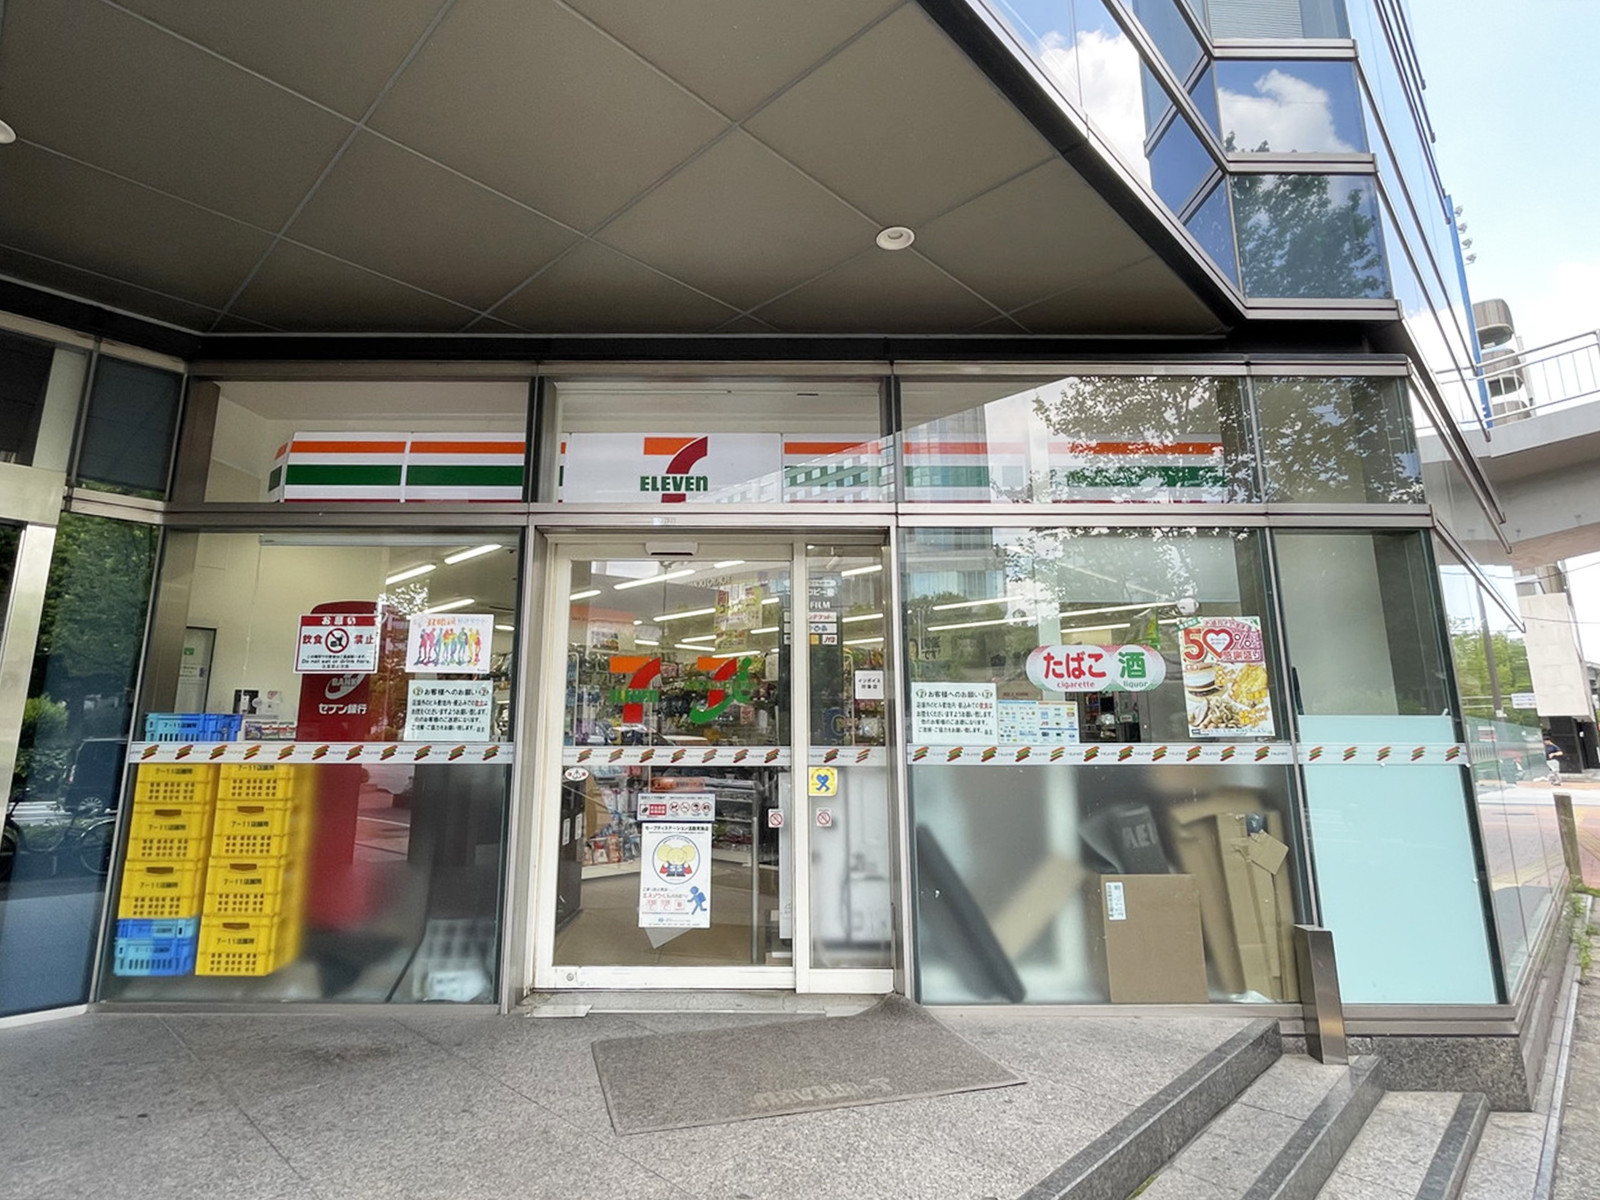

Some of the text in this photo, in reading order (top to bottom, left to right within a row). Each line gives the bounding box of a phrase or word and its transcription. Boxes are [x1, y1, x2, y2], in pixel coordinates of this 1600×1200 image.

[1043, 650, 1147, 679] たばこ 酒
[1057, 681, 1148, 690] cigarette liquor
[318, 703, 369, 715] セブン銀行
